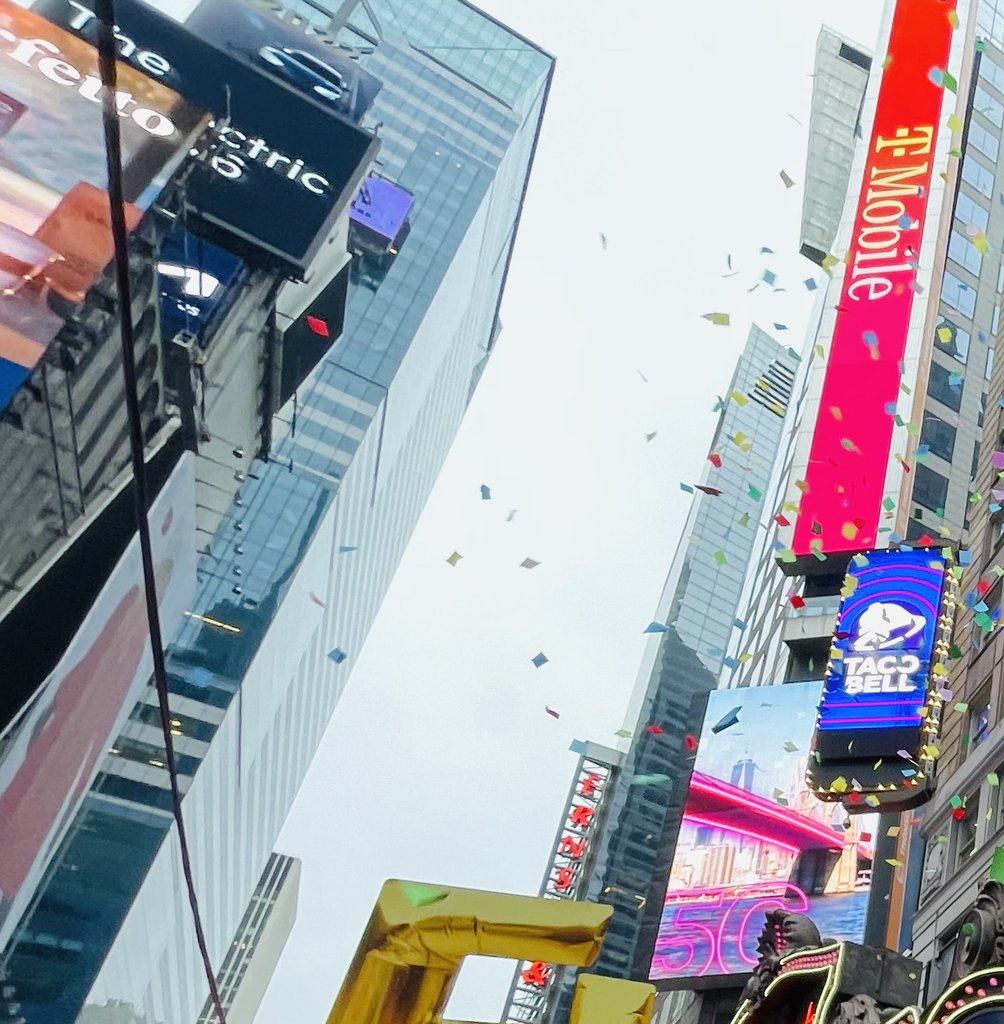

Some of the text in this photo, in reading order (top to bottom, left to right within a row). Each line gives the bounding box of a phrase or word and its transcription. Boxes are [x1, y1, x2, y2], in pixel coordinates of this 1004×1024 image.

[214, 126, 330, 195] ctric
[843, 654, 920, 676] TACO
[844, 673, 917, 694] BELL
[554, 771, 600, 891] ERNS
